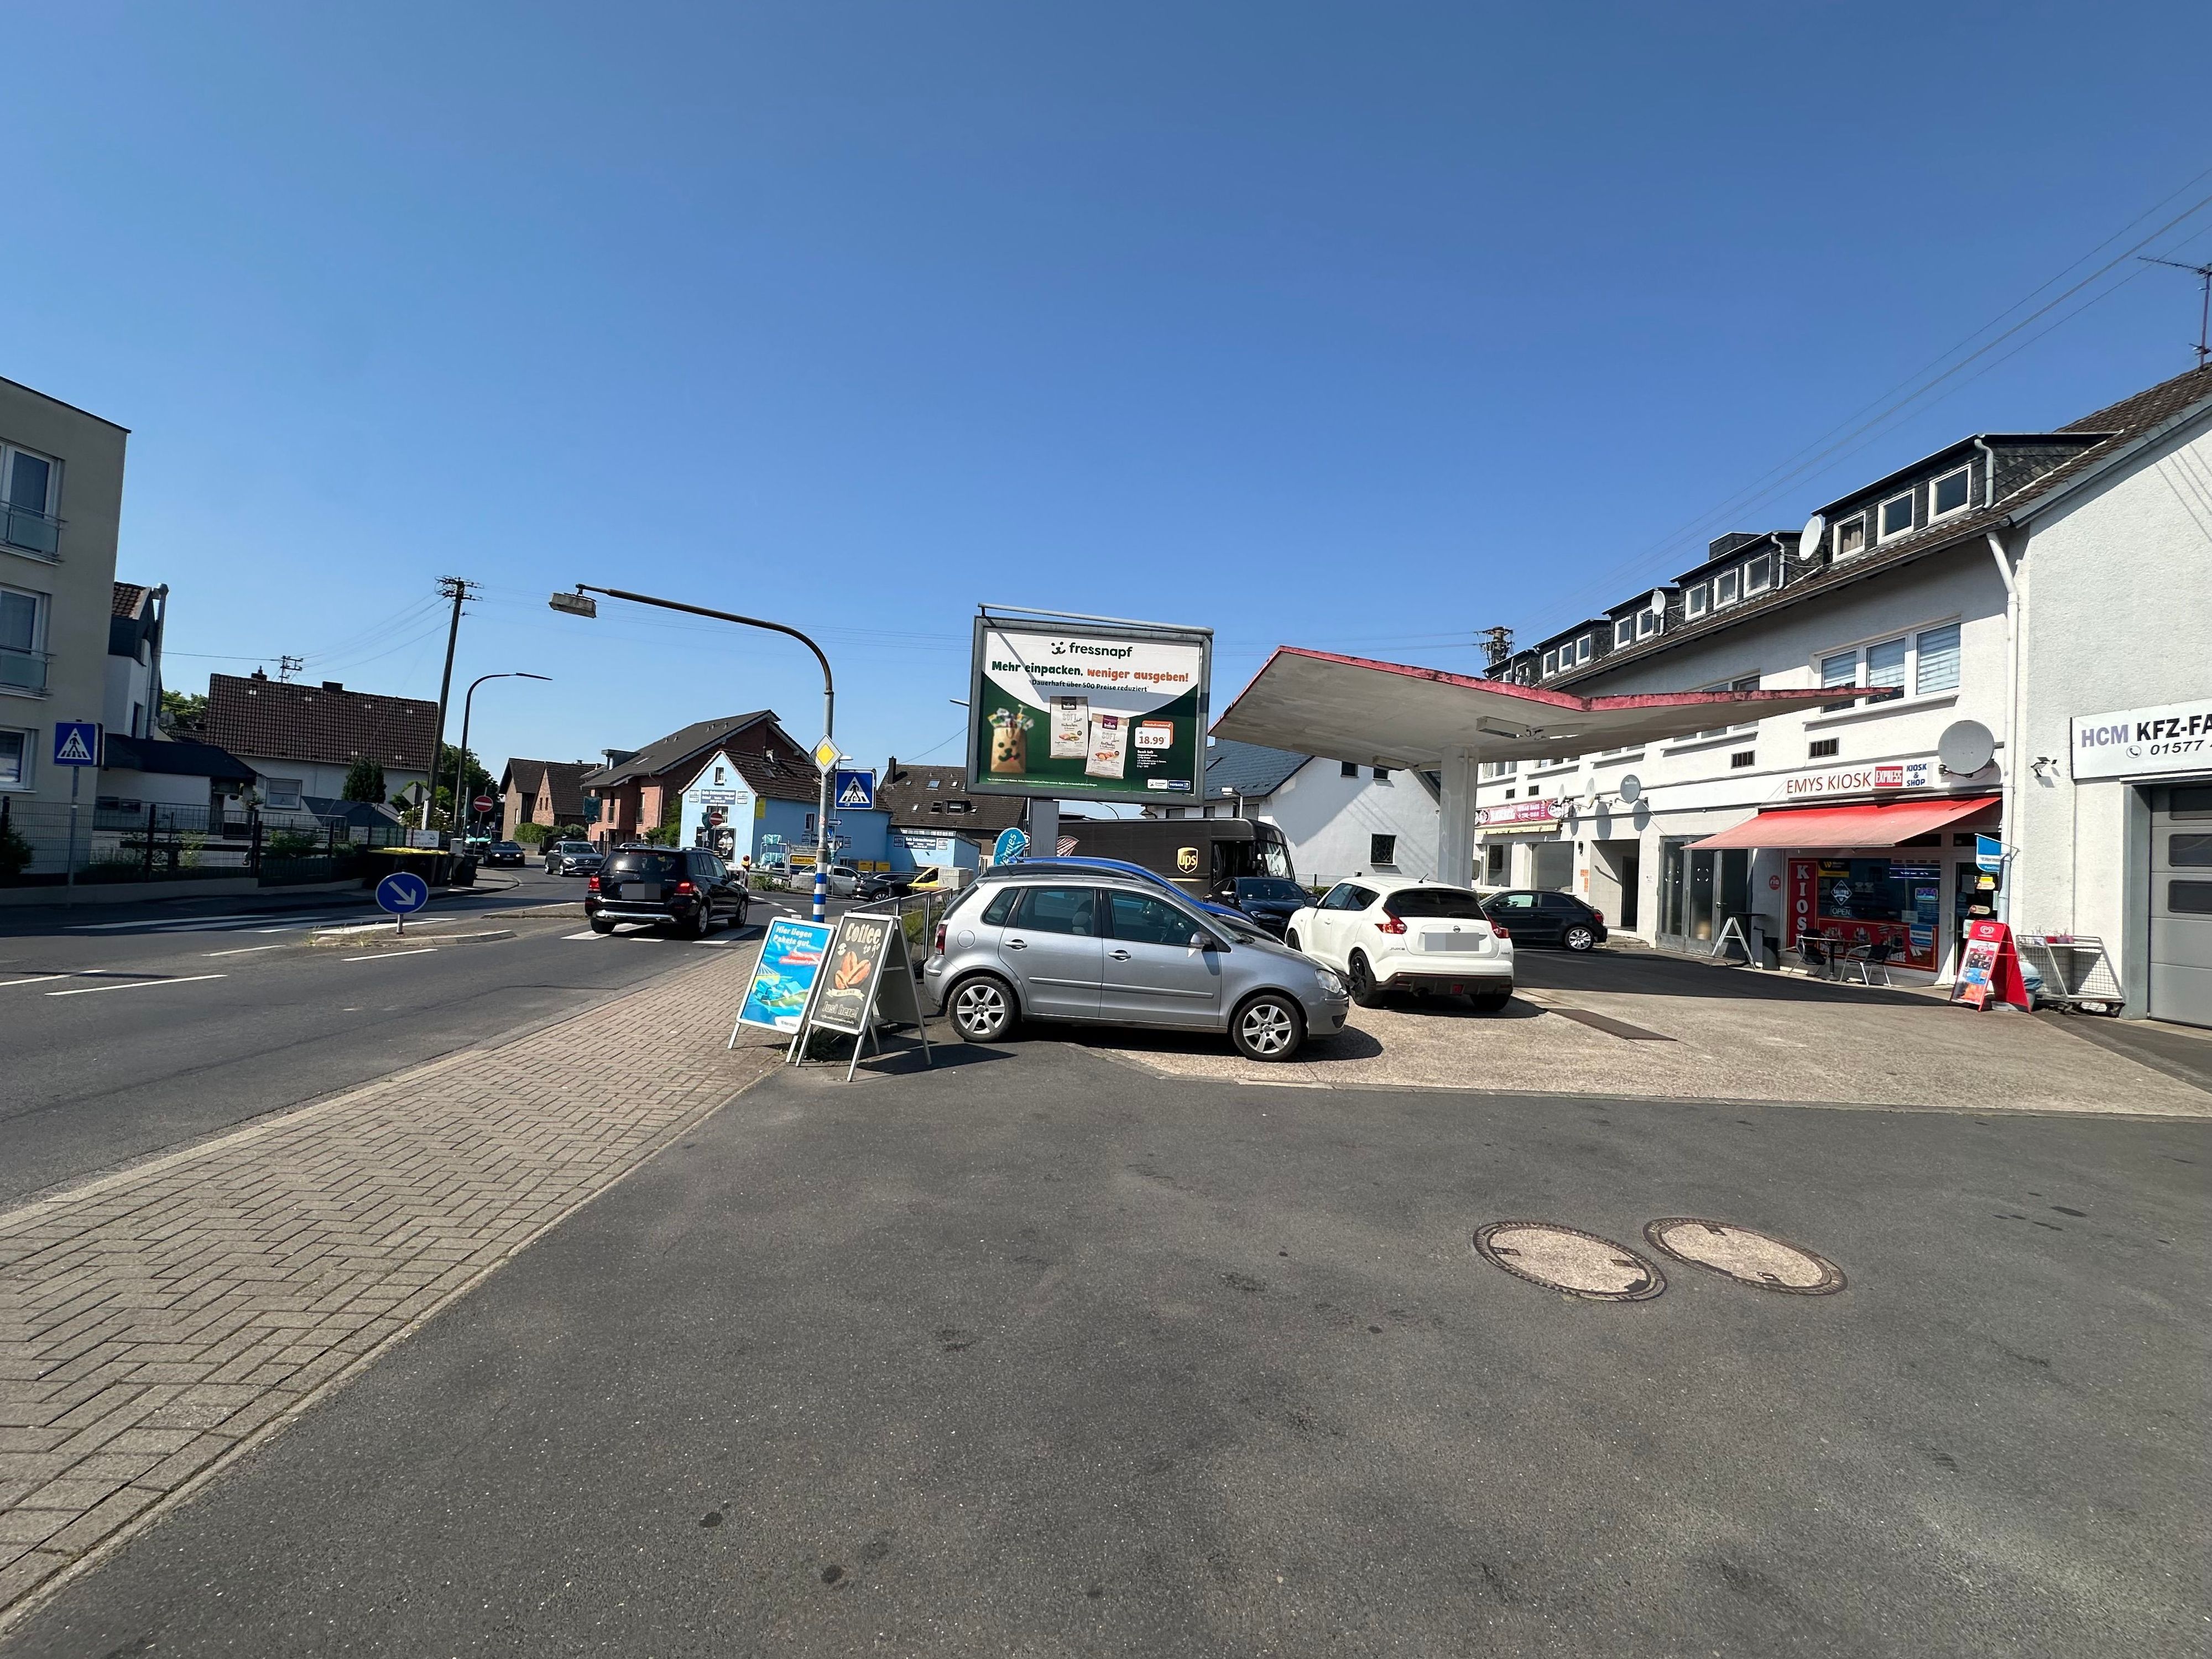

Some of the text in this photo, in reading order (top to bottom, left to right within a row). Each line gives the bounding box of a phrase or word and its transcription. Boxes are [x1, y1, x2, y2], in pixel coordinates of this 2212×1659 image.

[1070, 643, 1133, 659] fressnapf
[992, 661, 1189, 684] Mehr einpacken, weniger ausgeben!
[1066, 680, 1081, 688] über
[1102, 731, 1116, 740] SOFT
[1139, 735, 1165, 745] 18.99
[2081, 724, 2129, 748] HCM
[2150, 740, 2204, 755] 01577
[1906, 763, 1927, 772] KIOSK
[1787, 771, 1872, 794] EMYS KIOSK
[1875, 770, 1902, 784] EXPRESS
[1906, 779, 1926, 787] SHOP
[1179, 854, 1197, 869] ups
[775, 925, 813, 938] Hier liegen
[846, 922, 881, 945] Coffee
[773, 934, 796, 945] Pakete
[863, 942, 881, 958] to go
[822, 1000, 859, 1018] Just here!
